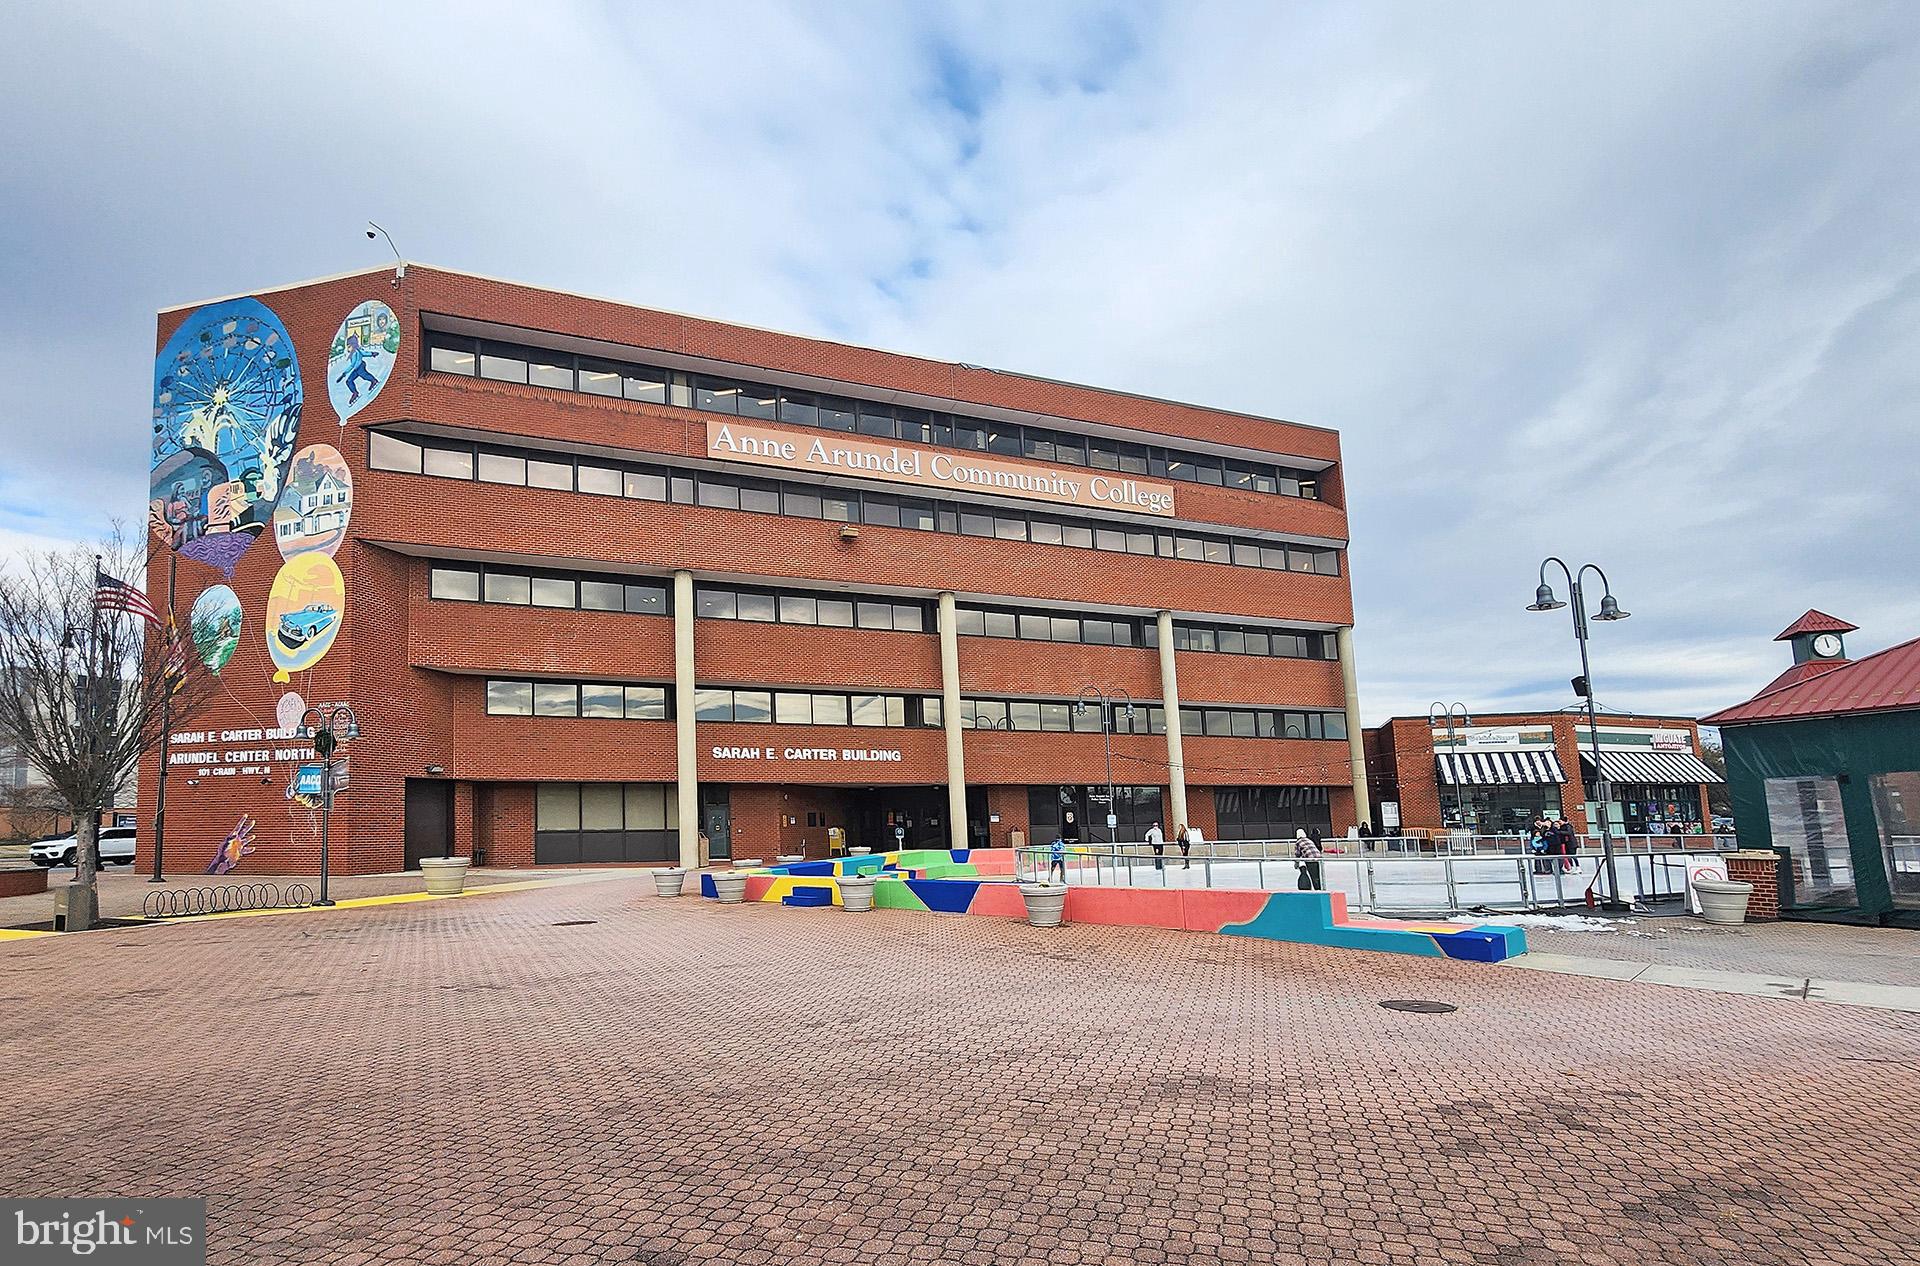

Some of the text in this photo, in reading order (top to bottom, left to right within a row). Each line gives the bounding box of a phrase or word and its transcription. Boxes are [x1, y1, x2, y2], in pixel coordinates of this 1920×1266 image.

[711, 424, 1174, 512] Anne Arundel Community College
[170, 731, 205, 744] SARAH
[221, 729, 262, 742] CARTER
[266, 726, 317, 740] BUILDG
[169, 748, 315, 765] ARUNDEL CENTER NORTH
[712, 747, 902, 762] SARAH E. CARTER BUILDING
[198, 767, 210, 776] 101
[212, 767, 236, 776] CRAIN
